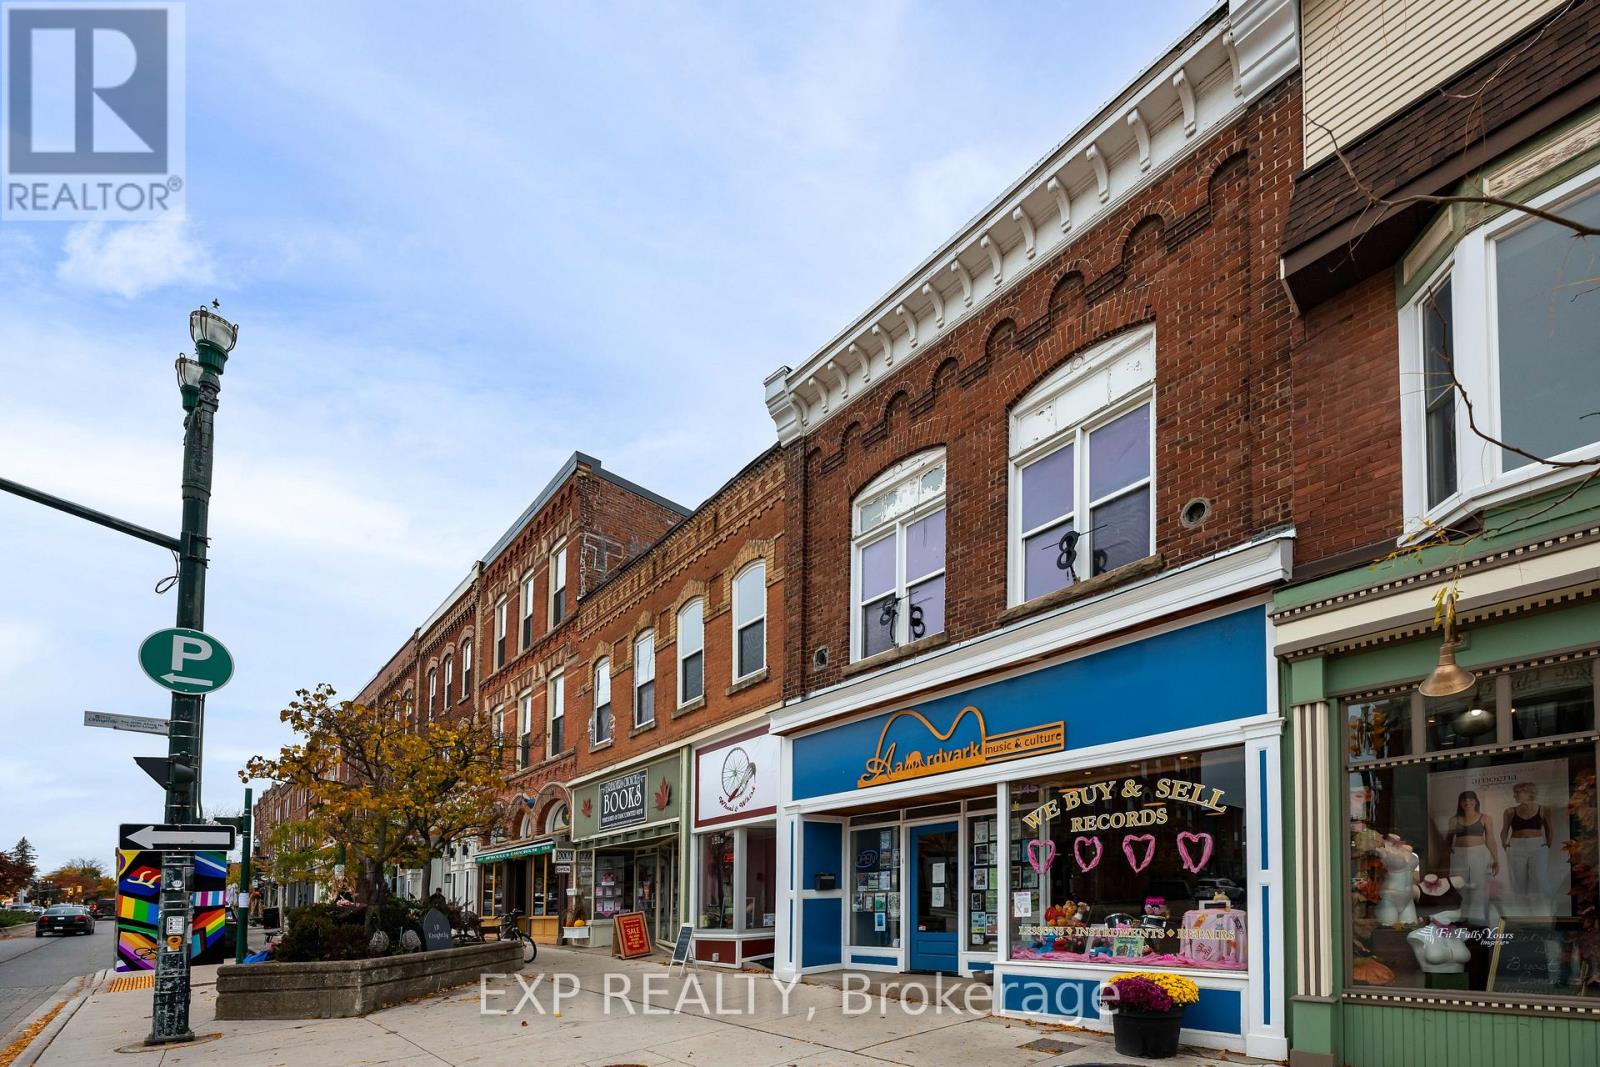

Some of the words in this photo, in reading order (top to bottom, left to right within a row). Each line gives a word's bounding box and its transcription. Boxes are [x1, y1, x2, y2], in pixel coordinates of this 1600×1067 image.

[171, 635, 213, 671] P
[985, 743, 1012, 755] music
[1014, 740, 1022, 749] &
[1024, 732, 1062, 747] culture
[603, 784, 642, 814] BOOKS
[1022, 799, 1061, 829] WE
[1063, 780, 1117, 811] BUY
[1121, 779, 1142, 798] &
[1155, 778, 1228, 812] SELL
[1070, 807, 1168, 833] RECORDS
[627, 927, 641, 935] SALE
[1018, 926, 1065, 937] LESSONS
[1074, 926, 1165, 939] INSTRUMENTS
[1177, 928, 1236, 940] REPAIRS
[1436, 927, 1452, 939] Fit
[1455, 927, 1483, 942] Fully
[1482, 926, 1514, 939] Yours
